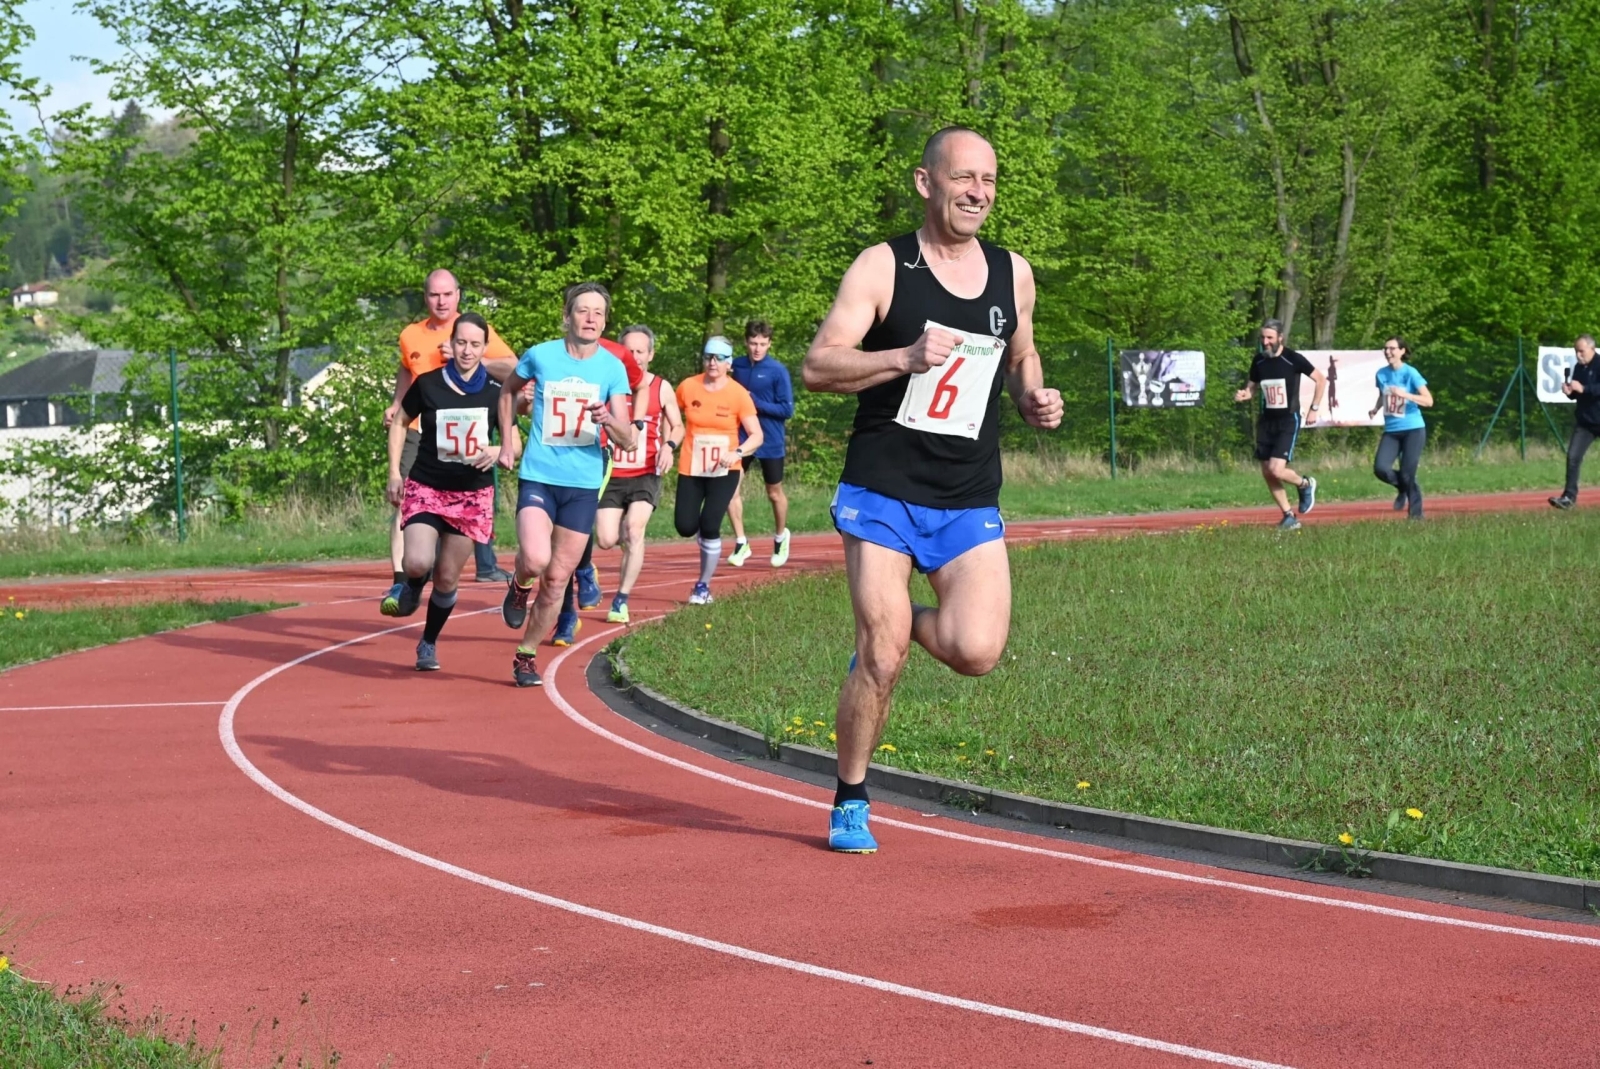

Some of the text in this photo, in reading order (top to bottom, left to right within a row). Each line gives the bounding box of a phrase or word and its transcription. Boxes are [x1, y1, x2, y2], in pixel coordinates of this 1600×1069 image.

[963, 344, 995, 356] TRUTNOV
[926, 356, 966, 420] 6
[552, 397, 589, 438] 57
[446, 421, 478, 457] 56
[701, 446, 720, 473] 19
